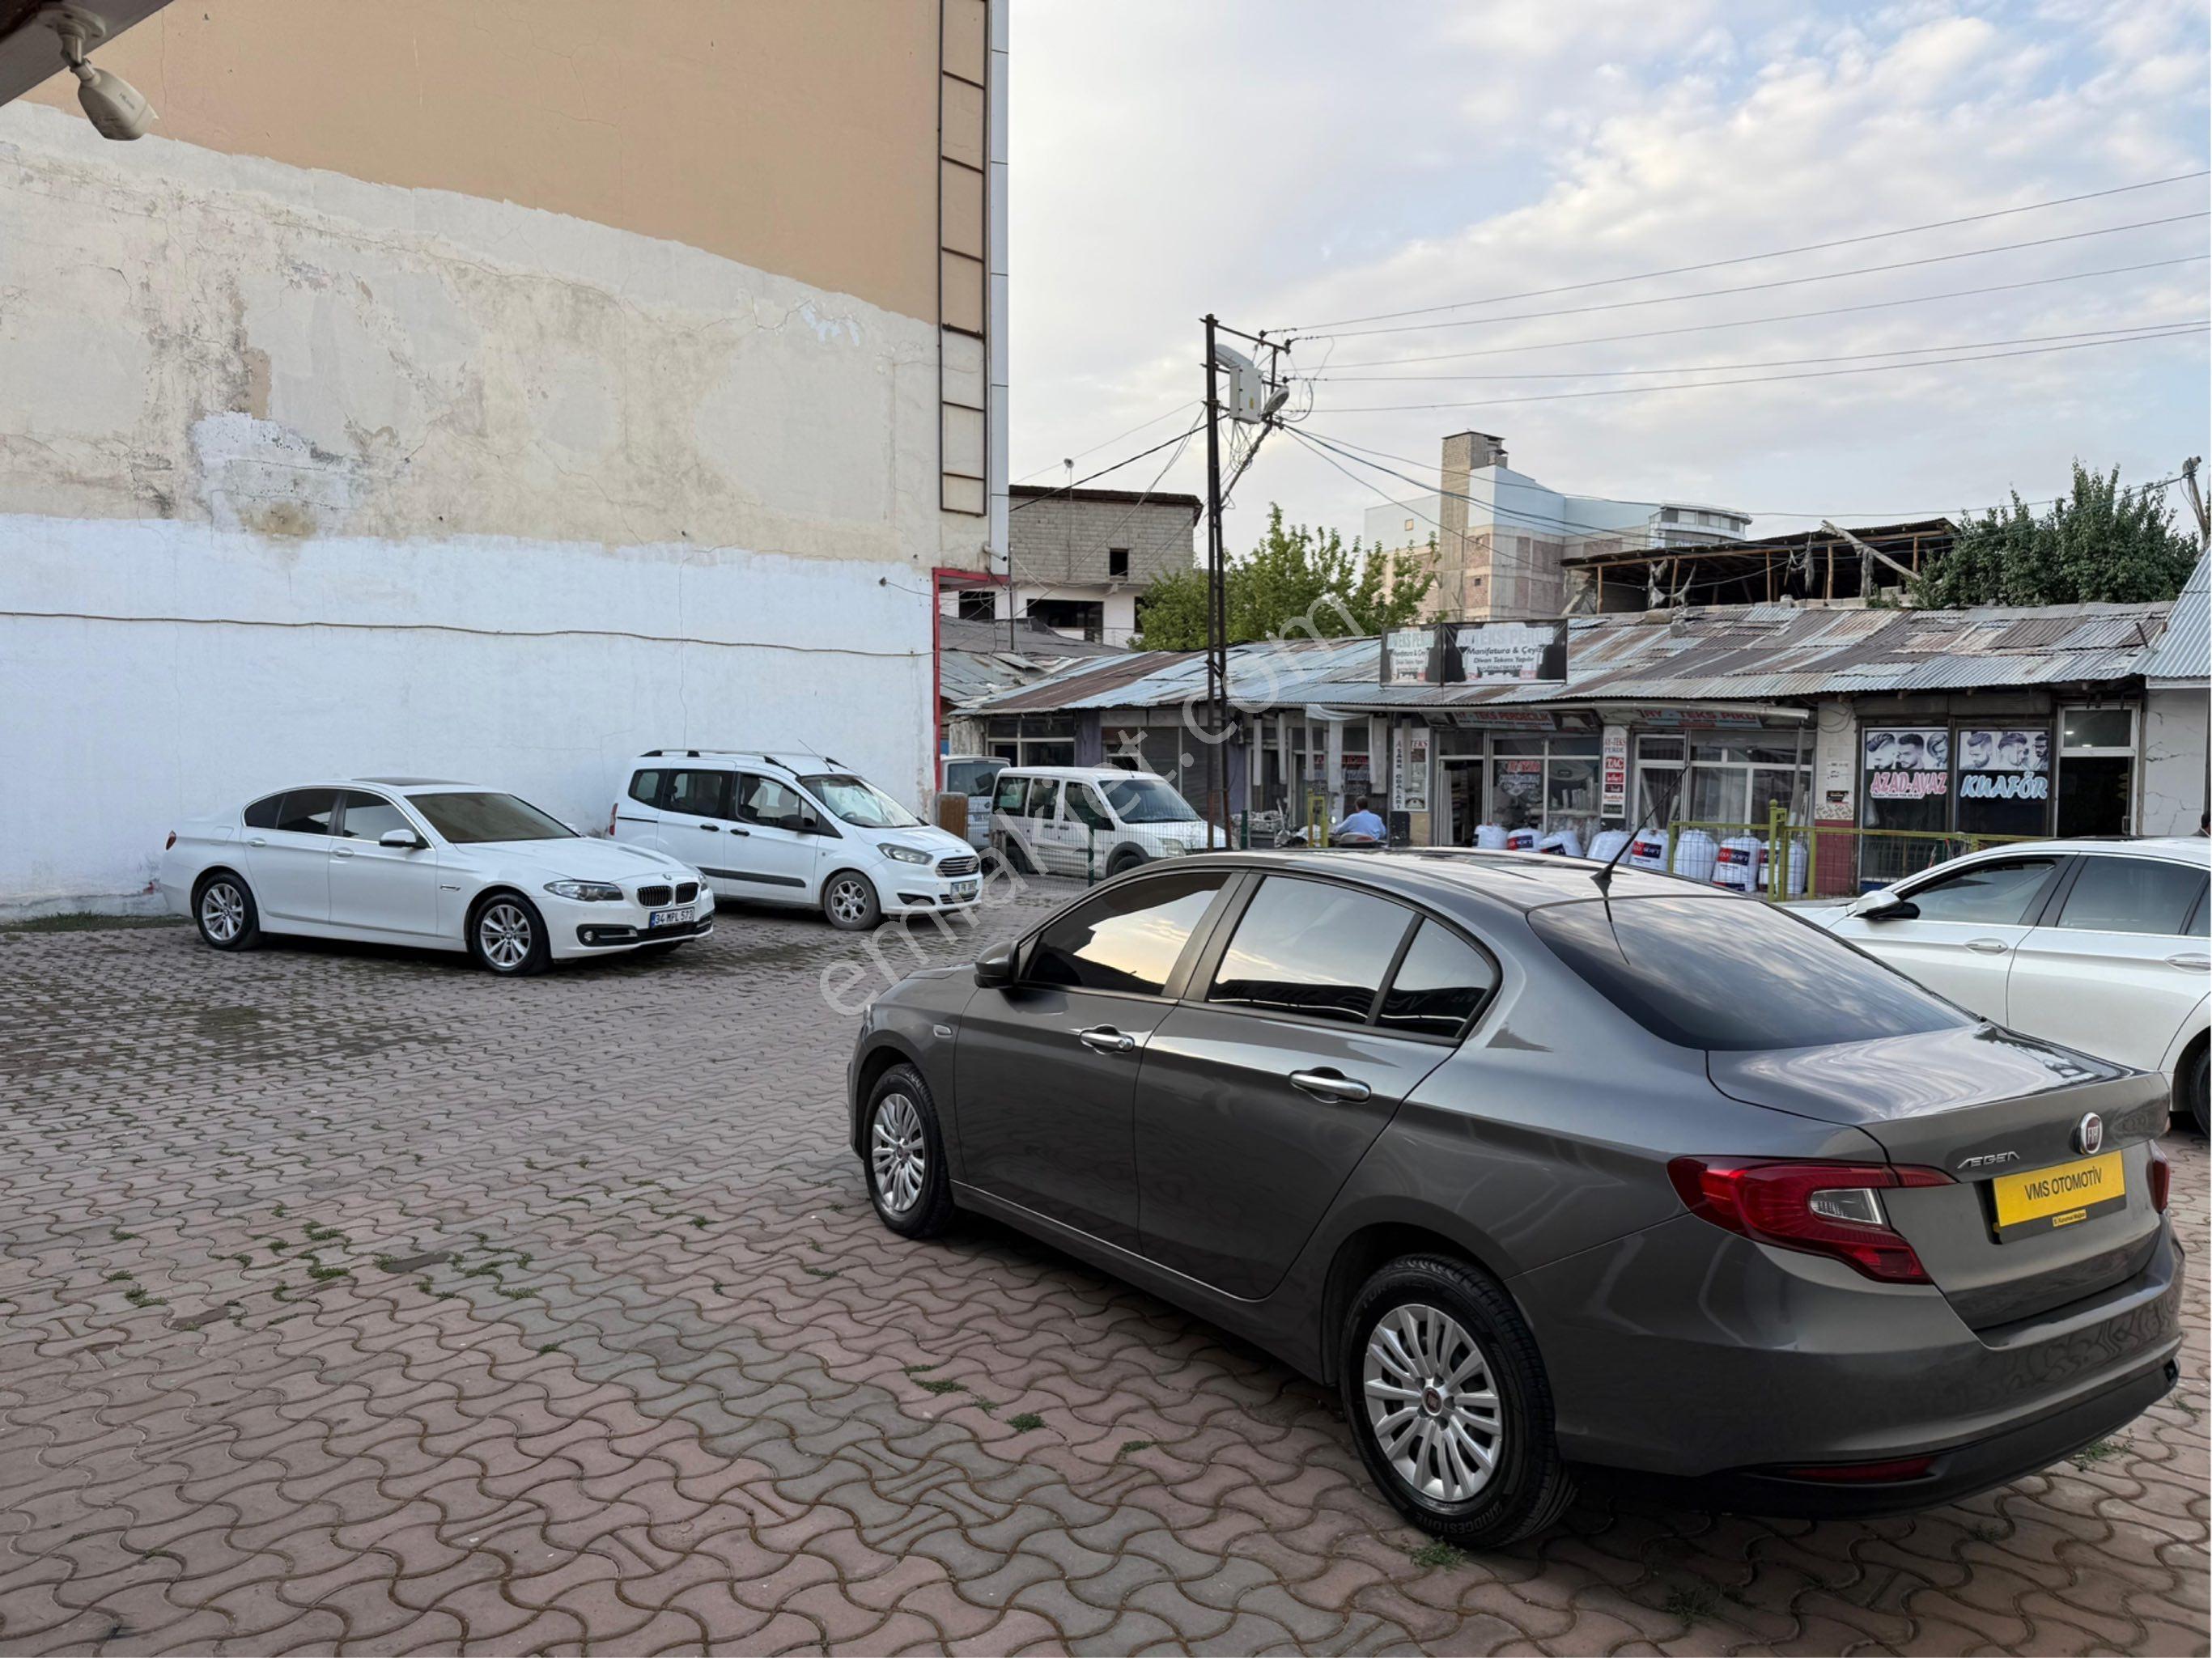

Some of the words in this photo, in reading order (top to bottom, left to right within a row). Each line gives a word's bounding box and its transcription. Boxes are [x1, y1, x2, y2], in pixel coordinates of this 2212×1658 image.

[1467, 647, 1511, 655] Manifatura
[656, 914, 665, 924] 34
[2024, 1181, 2050, 1201] VMS
[2051, 1165, 2103, 1194] OTOMOTİV
